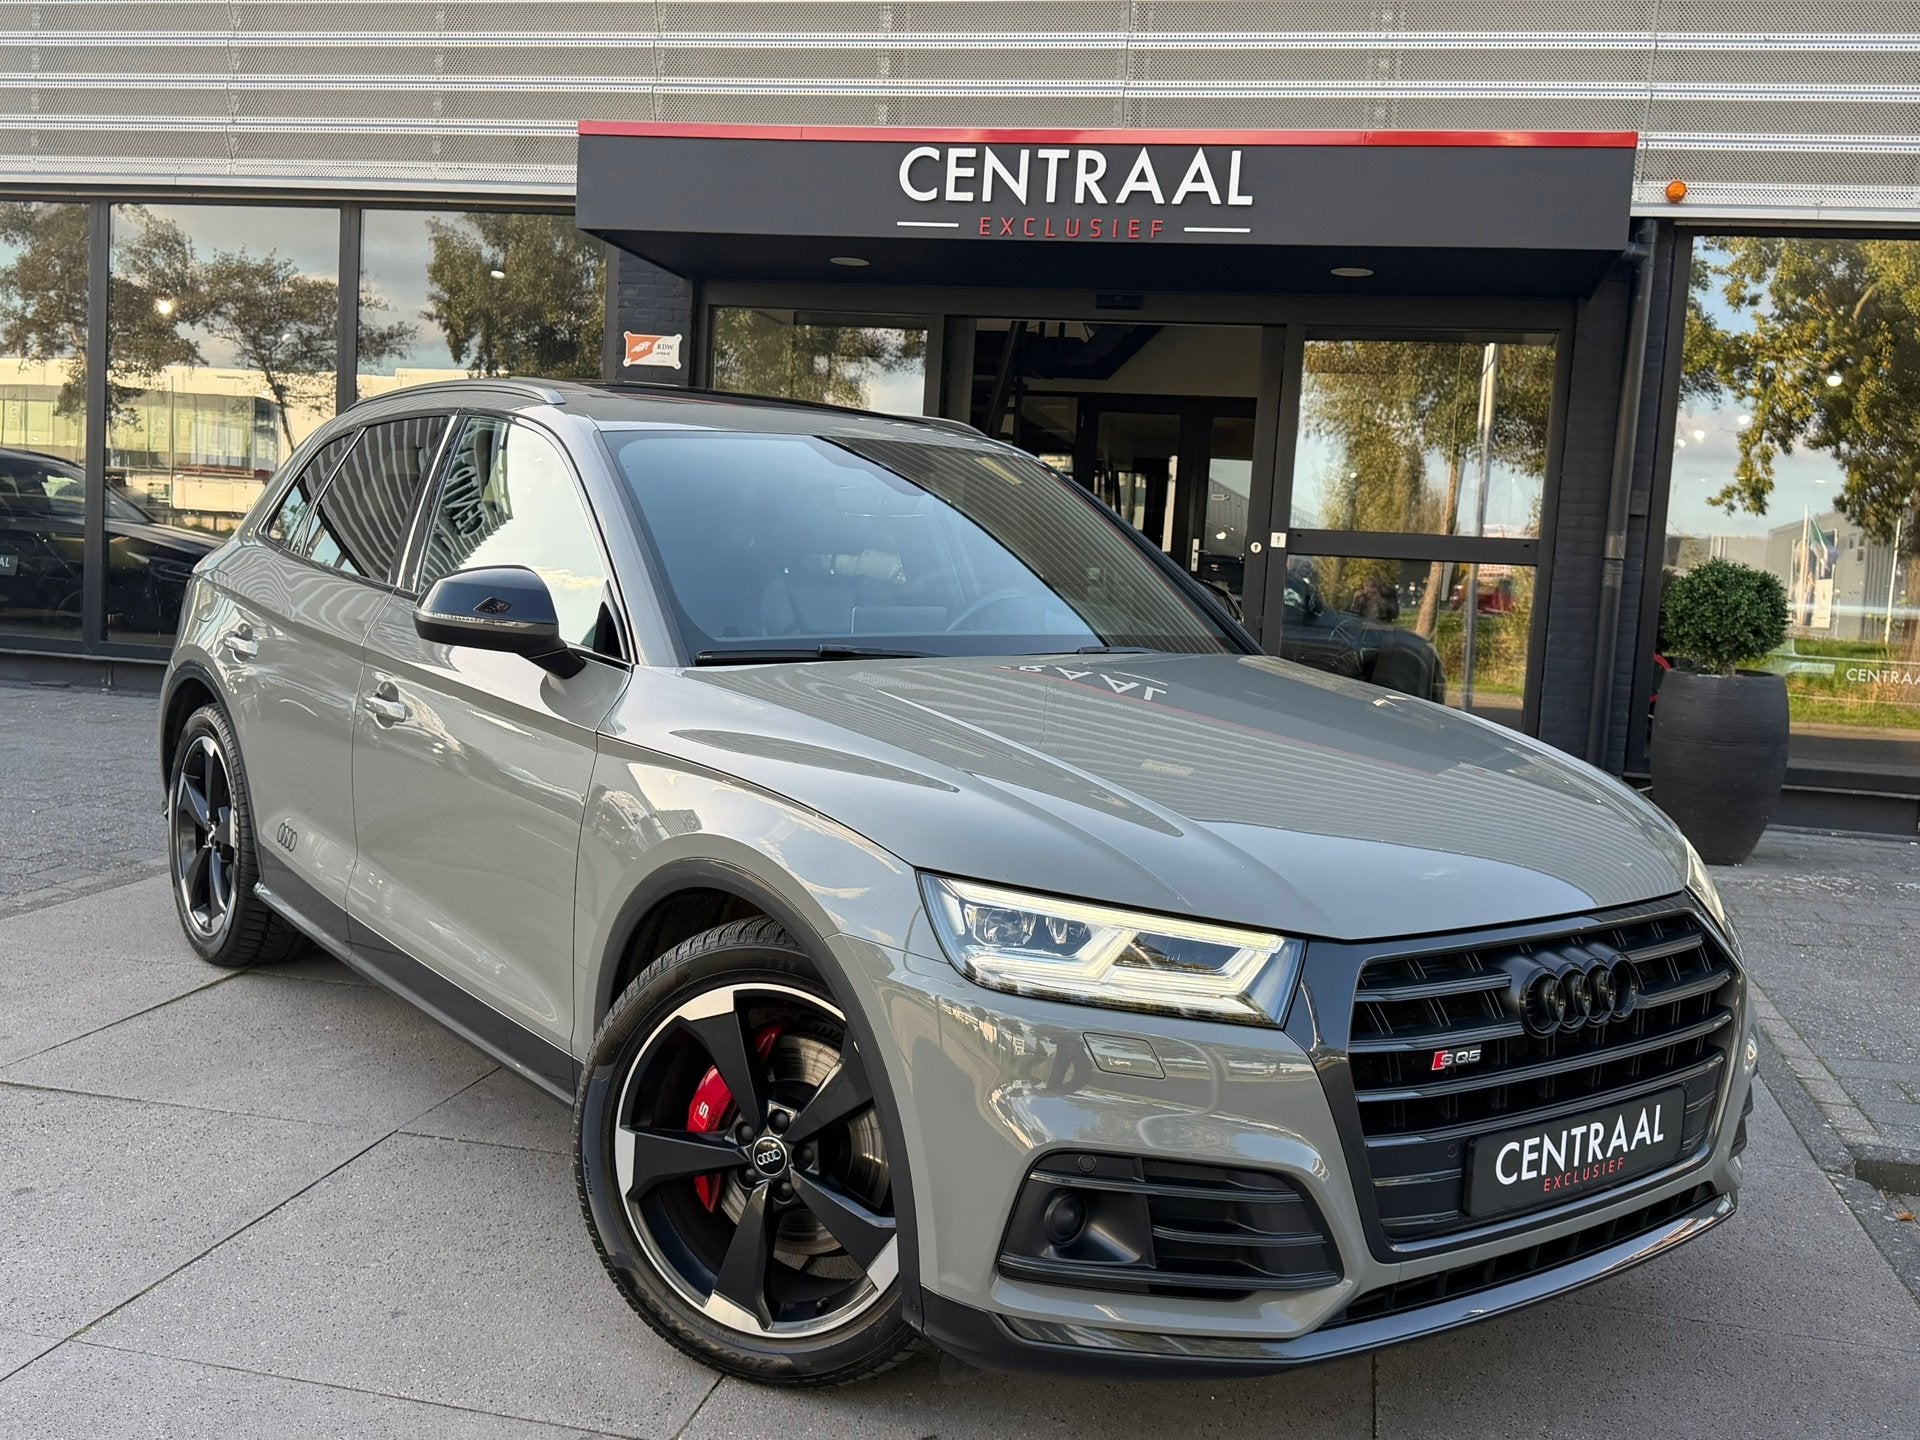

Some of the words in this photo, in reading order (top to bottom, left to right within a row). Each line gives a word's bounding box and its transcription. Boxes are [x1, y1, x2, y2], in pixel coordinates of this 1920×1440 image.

[898, 146, 1253, 206] CENTRAAL
[979, 216, 1165, 239] EXCLUSIEF
[1437, 1050, 1482, 1068] SQ5
[699, 1101, 709, 1119] S
[1495, 1104, 1665, 1186] CENTRAAL
[1543, 1158, 1625, 1193] EXCLUSIEF
